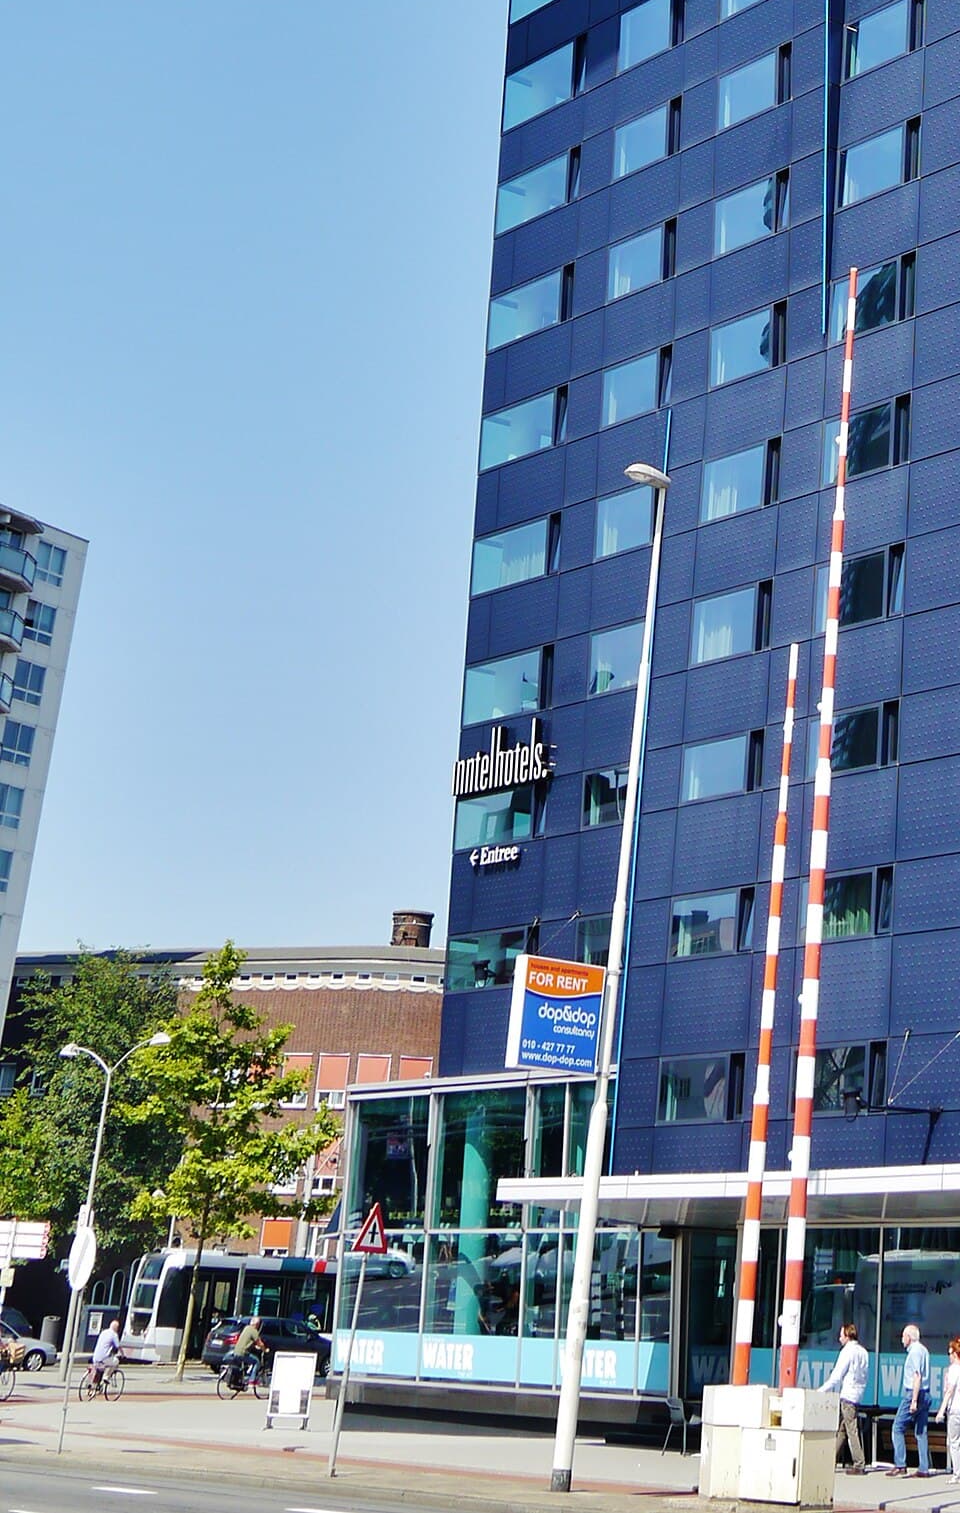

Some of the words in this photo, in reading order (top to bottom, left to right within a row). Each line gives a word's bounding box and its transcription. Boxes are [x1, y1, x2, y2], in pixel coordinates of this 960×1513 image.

[479, 845, 519, 866] Entree
[528, 971, 553, 987] FOR
[556, 975, 588, 992] RENT
[538, 1002, 596, 1028] dop&dop
[553, 1025, 595, 1040] consultancy
[522, 1039, 536, 1048] 010
[541, 1041, 555, 1052] 427
[556, 1043, 565, 1053] 77
[566, 1044, 575, 1054] 77
[521, 1051, 592, 1068] www.dop-dop.com
[422, 1341, 474, 1371] WATER
